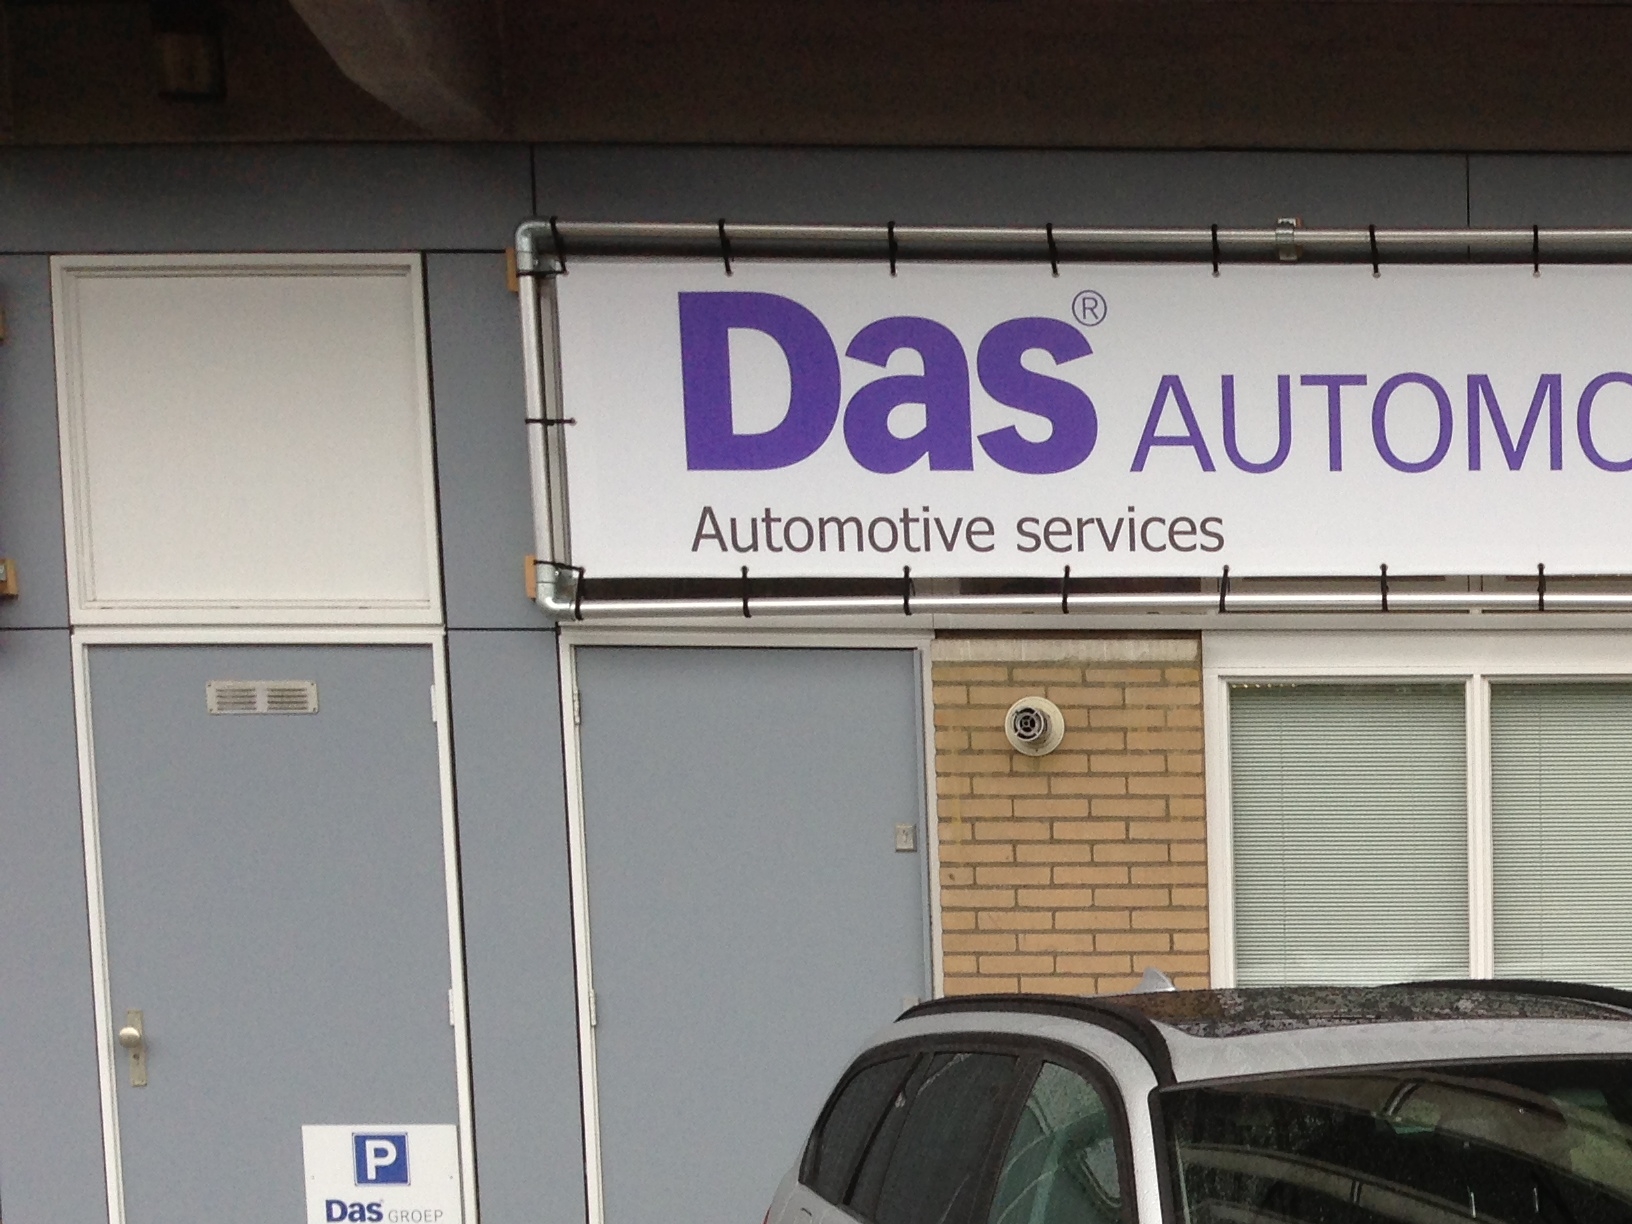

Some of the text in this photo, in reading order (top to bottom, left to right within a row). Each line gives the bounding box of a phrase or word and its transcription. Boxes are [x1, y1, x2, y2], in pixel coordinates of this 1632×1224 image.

[691, 505, 1226, 554] Automotive services
[365, 1138, 397, 1181] P
[325, 1199, 444, 1223] Das GROEP
